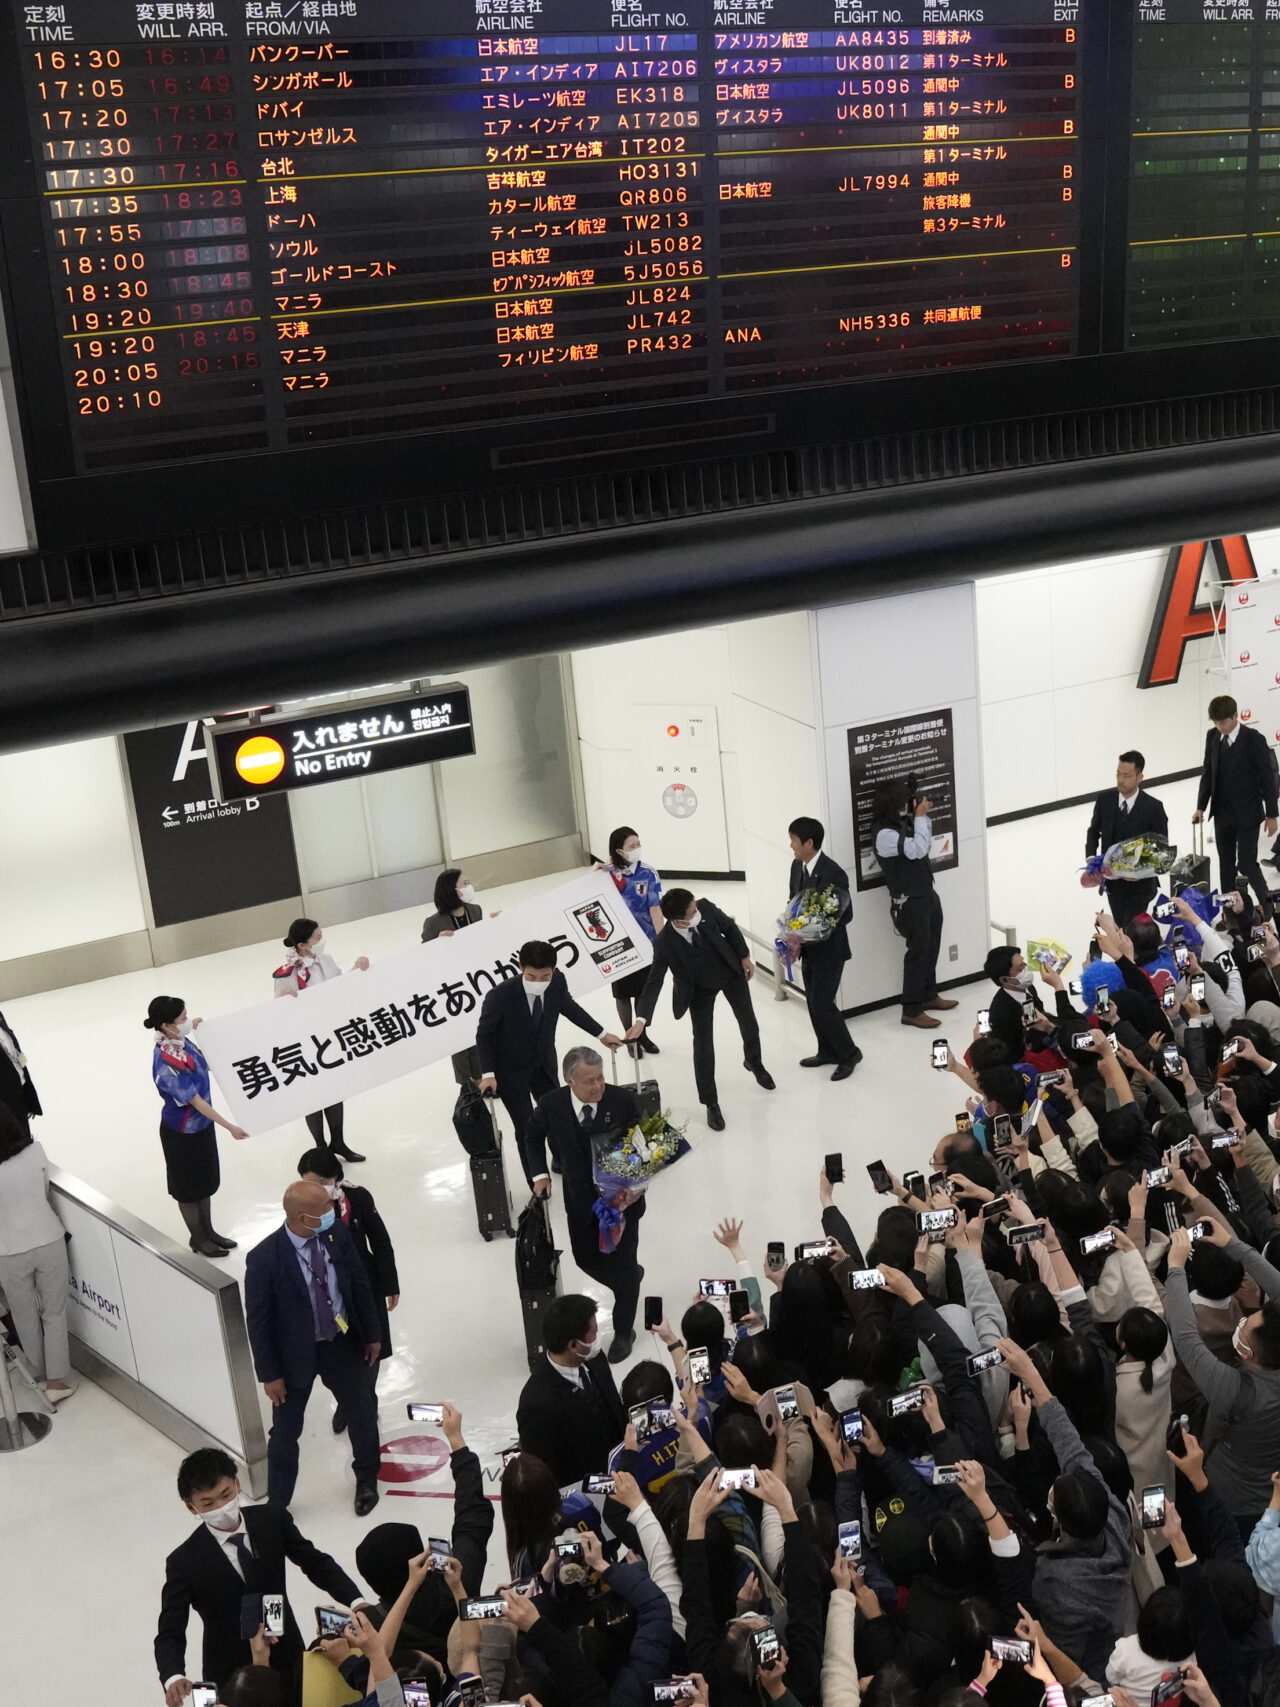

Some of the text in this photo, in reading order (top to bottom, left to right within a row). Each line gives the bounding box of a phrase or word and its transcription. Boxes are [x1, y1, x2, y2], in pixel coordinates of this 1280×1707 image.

[24, 5, 65, 23] 定刻
[136, 2, 215, 21] 変更時刻
[245, 1, 357, 19] 起点／経由地
[475, 0, 543, 14] 航空会社
[923, 10, 984, 22] REMARKS
[1054, 9, 1079, 21] EXIT
[1139, 9, 1166, 21] TIME
[476, 15, 535, 31] AIRLINE
[611, 13, 689, 27] FLIGHT NO.
[714, 12, 766, 25] AIRLINE
[834, 10, 904, 24] FLIGHT NO.
[26, 26, 75, 41] TIME
[138, 22, 228, 39] WILL ARR.
[246, 20, 331, 36] FROM/VIA
[923, 30, 972, 45] 到着済み
[1065, 29, 1075, 43] B
[478, 37, 539, 57] 日本航空
[615, 35, 668, 52] JL17
[714, 32, 809, 49] アメリカン航空
[835, 30, 909, 47] AA8435
[34, 50, 121, 70] 16:30
[250, 43, 349, 62] バンクーバー
[923, 53, 1007, 69] 第1ターミナル
[480, 63, 598, 82] エア・インディア
[615, 60, 697, 78] AI7206
[714, 58, 783, 74] ヴィスタラ
[836, 55, 910, 71] UK8012
[38, 79, 124, 100] 17:05
[253, 71, 353, 91] シンガポール
[837, 79, 910, 96] JL5096
[923, 77, 960, 94] 通関中
[1064, 75, 1074, 89] B
[482, 90, 586, 109] エミレーツ航空
[617, 86, 684, 104] EK318
[716, 83, 770, 101] 日本航空
[257, 101, 304, 119] ドバイ
[716, 108, 783, 126] ヴィスタラ
[837, 103, 908, 120] UK8011
[923, 100, 1007, 117] 第1ターミナル
[42, 109, 128, 130] 17:20
[484, 115, 600, 136] エア・インディア
[618, 111, 699, 129] AI7205
[1064, 120, 1074, 134] B
[258, 127, 357, 147] ロサンゼルス
[923, 124, 960, 141] 通関中
[46, 138, 131, 159] 17:30
[156, 133, 235, 152] 17:27
[486, 141, 603, 163] タイガーエア台湾
[621, 137, 686, 156] IT202
[923, 146, 1007, 164] 第1ターミナル
[159, 161, 239, 181] 17:16
[261, 157, 295, 177] 台北
[620, 162, 698, 181] HO3131
[1063, 166, 1072, 179] B
[48, 167, 135, 189] 17:30
[486, 170, 546, 190] 吉祥航空
[839, 174, 911, 192] JL7994
[923, 171, 960, 188] 通関中
[162, 189, 242, 209] 18:23
[265, 186, 298, 205] 上海
[620, 187, 687, 206] QR806
[719, 182, 772, 200] 日本航空
[1063, 188, 1072, 202] B
[54, 195, 138, 218] 17:35
[488, 194, 577, 215] カタール航空
[923, 193, 971, 211] 旅客降機
[268, 213, 316, 228] ドーハ
[490, 218, 607, 241] ティーウェイ航空
[622, 212, 689, 231] TW213
[923, 214, 1006, 234] 第3ターミナル
[58, 224, 141, 246] 17:55
[270, 239, 319, 258] ソウル
[624, 235, 702, 256] JL5082
[62, 252, 145, 275] 18:00
[492, 247, 550, 268] 日本航空
[1062, 254, 1071, 268] B
[271, 261, 397, 285] ゴールドコースト
[624, 260, 703, 281] 5J5056
[66, 280, 148, 303] 18:30
[173, 271, 250, 293] 18:45
[275, 293, 322, 311] マニラ
[626, 286, 691, 306] JL824
[176, 299, 253, 321] 19:40
[495, 298, 553, 319] 日本航空
[923, 306, 982, 325] 共同運航便
[72, 308, 152, 331] 19:20
[627, 310, 692, 330] JL742
[839, 312, 910, 332] NH5336
[179, 326, 256, 348] 18:45
[277, 320, 310, 340] 天津
[497, 323, 554, 344] 日本航空
[724, 326, 761, 343] ANA
[74, 336, 155, 359] 19:20
[628, 334, 693, 354] PR432
[180, 353, 258, 376] 20:15
[280, 346, 327, 364] マニラ
[498, 343, 599, 368] フィリピン航空
[75, 363, 158, 387] 20:05
[283, 372, 330, 390] マニラ
[79, 390, 161, 415] 20:10
[1136, 534, 1260, 690] A
[411, 714, 450, 731] 진입금지
[292, 714, 404, 753] 入れません
[172, 717, 217, 782] A
[294, 750, 371, 776] No Entry
[163, 820, 180, 828] 100m
[186, 806, 241, 824] Arrival lobby
[231, 934, 580, 1100] 勇気と感動をありがう
[82, 1279, 121, 1321] Airport
[652, 1437, 681, 1466] H.IT
